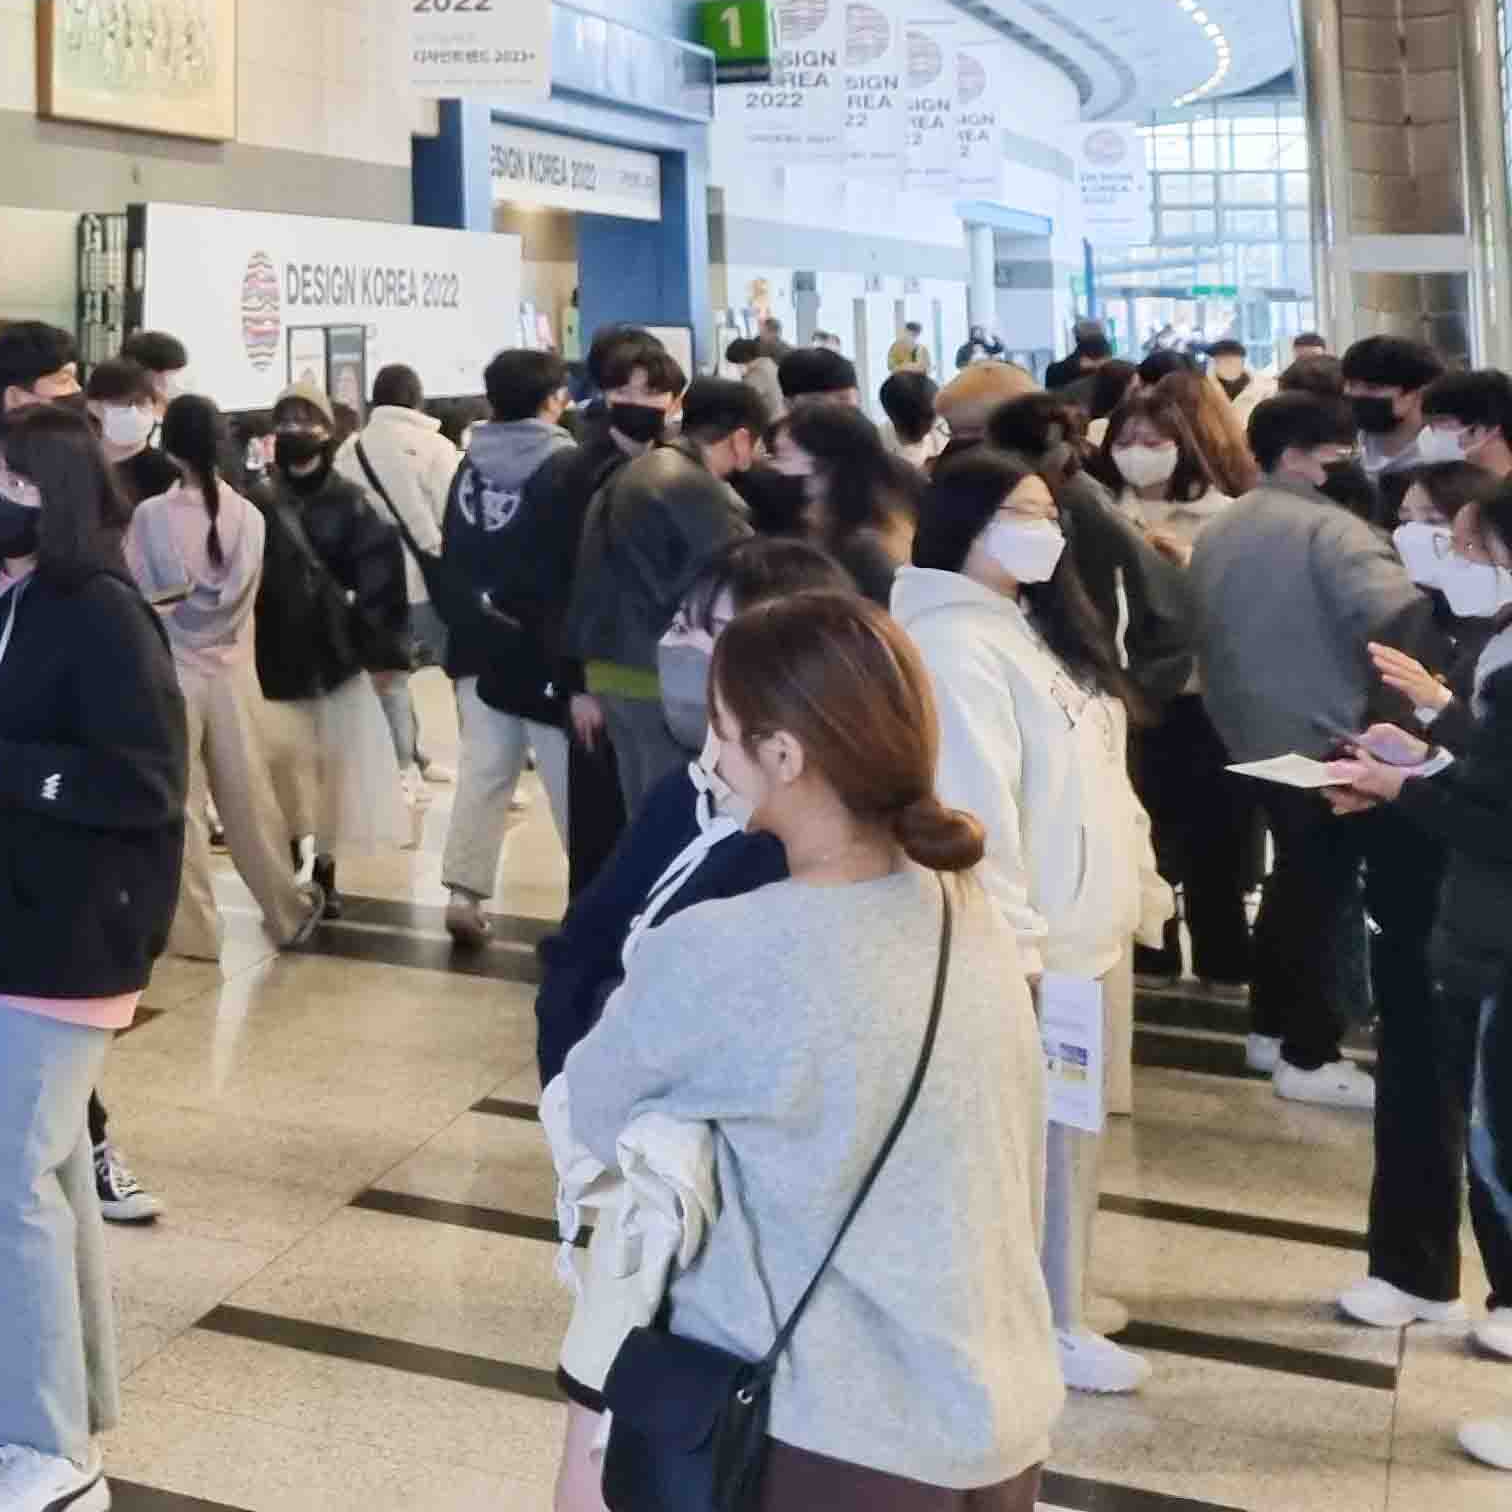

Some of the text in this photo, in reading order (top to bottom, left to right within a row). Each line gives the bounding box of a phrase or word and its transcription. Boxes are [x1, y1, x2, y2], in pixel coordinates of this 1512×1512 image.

[719, 4, 744, 49] 1
[780, 49, 837, 68] SIGN
[844, 74, 899, 90] SIGN
[745, 92, 805, 109] 2022
[847, 94, 893, 110] REA
[844, 112, 868, 128] 22
[490, 143, 526, 180] ESIGN
[529, 151, 568, 186] KOREA
[286, 263, 459, 307] DESIGN KOREA 2022
